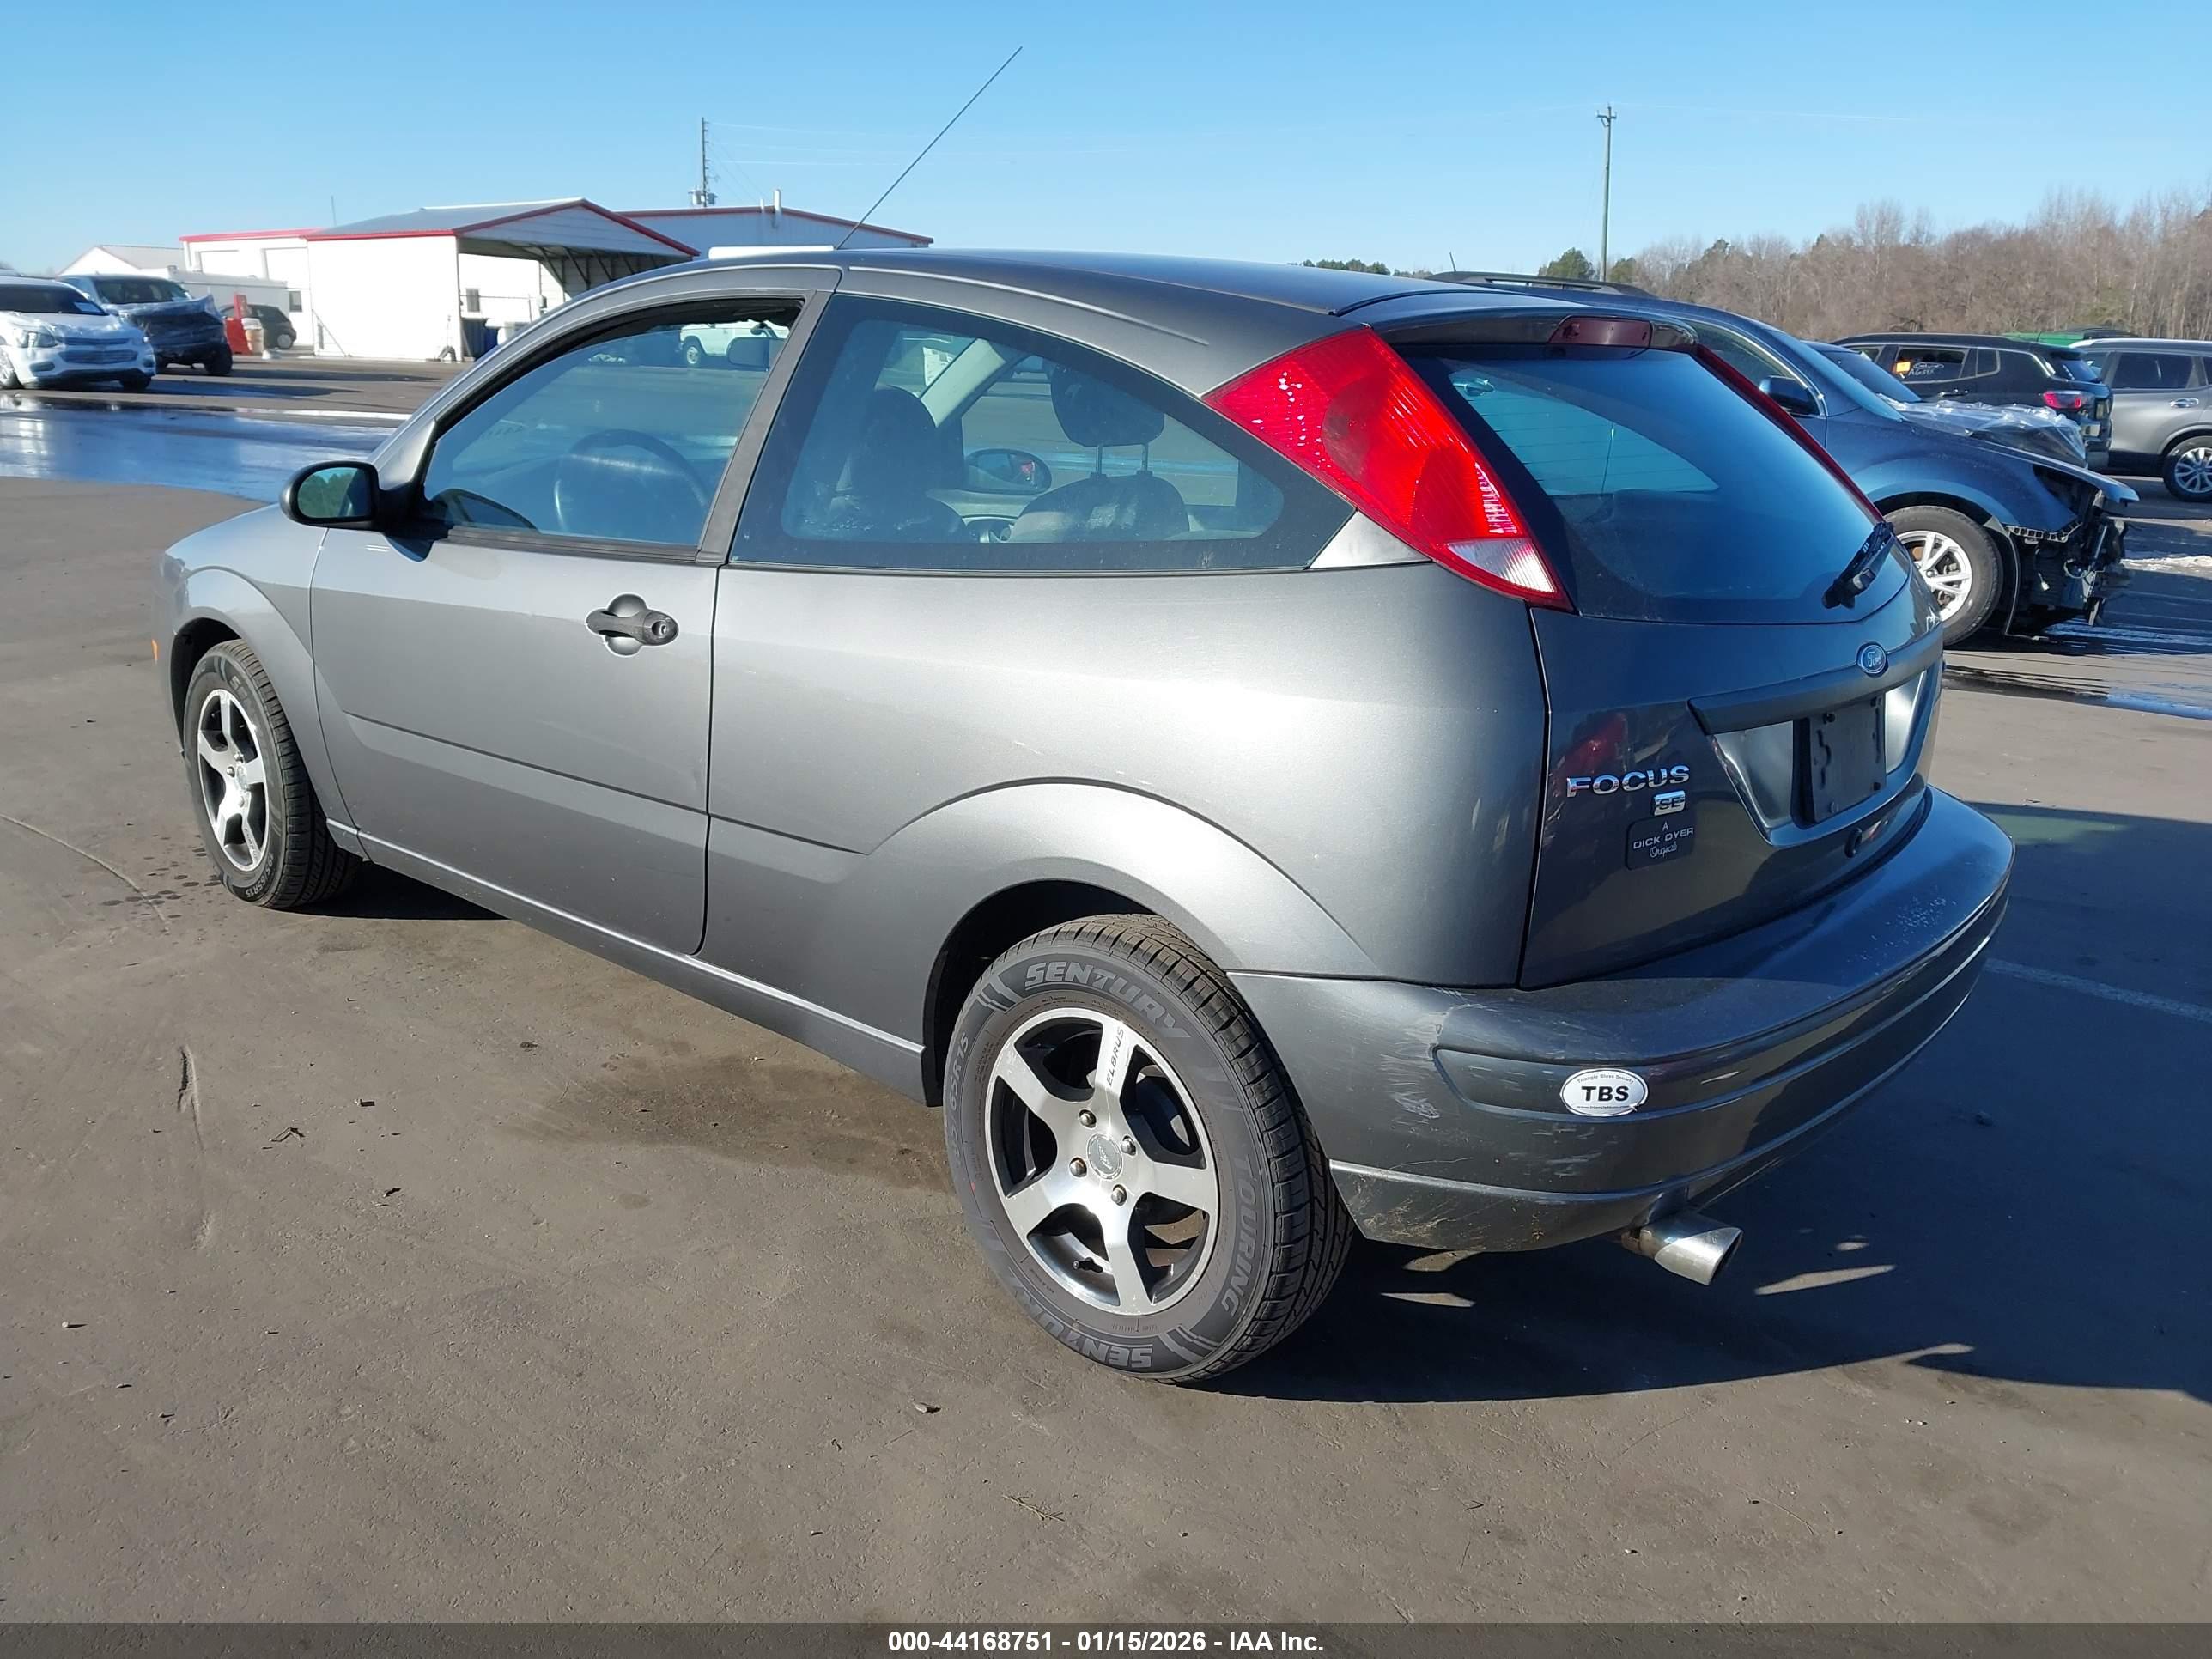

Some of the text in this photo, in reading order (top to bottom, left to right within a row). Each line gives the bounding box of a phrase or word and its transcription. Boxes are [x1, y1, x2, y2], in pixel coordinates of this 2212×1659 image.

[1566, 765, 1690, 798] FOCUS
[1657, 796, 1685, 811] SE
[1633, 827, 1694, 849] DICK DYER
[1662, 821, 1669, 831] A
[1024, 961, 1192, 1038] SENTURY
[1106, 1027, 1125, 1087] ELBRUS
[1581, 1085, 1630, 1102] TBS
[1220, 1152, 1259, 1317] TOURING
